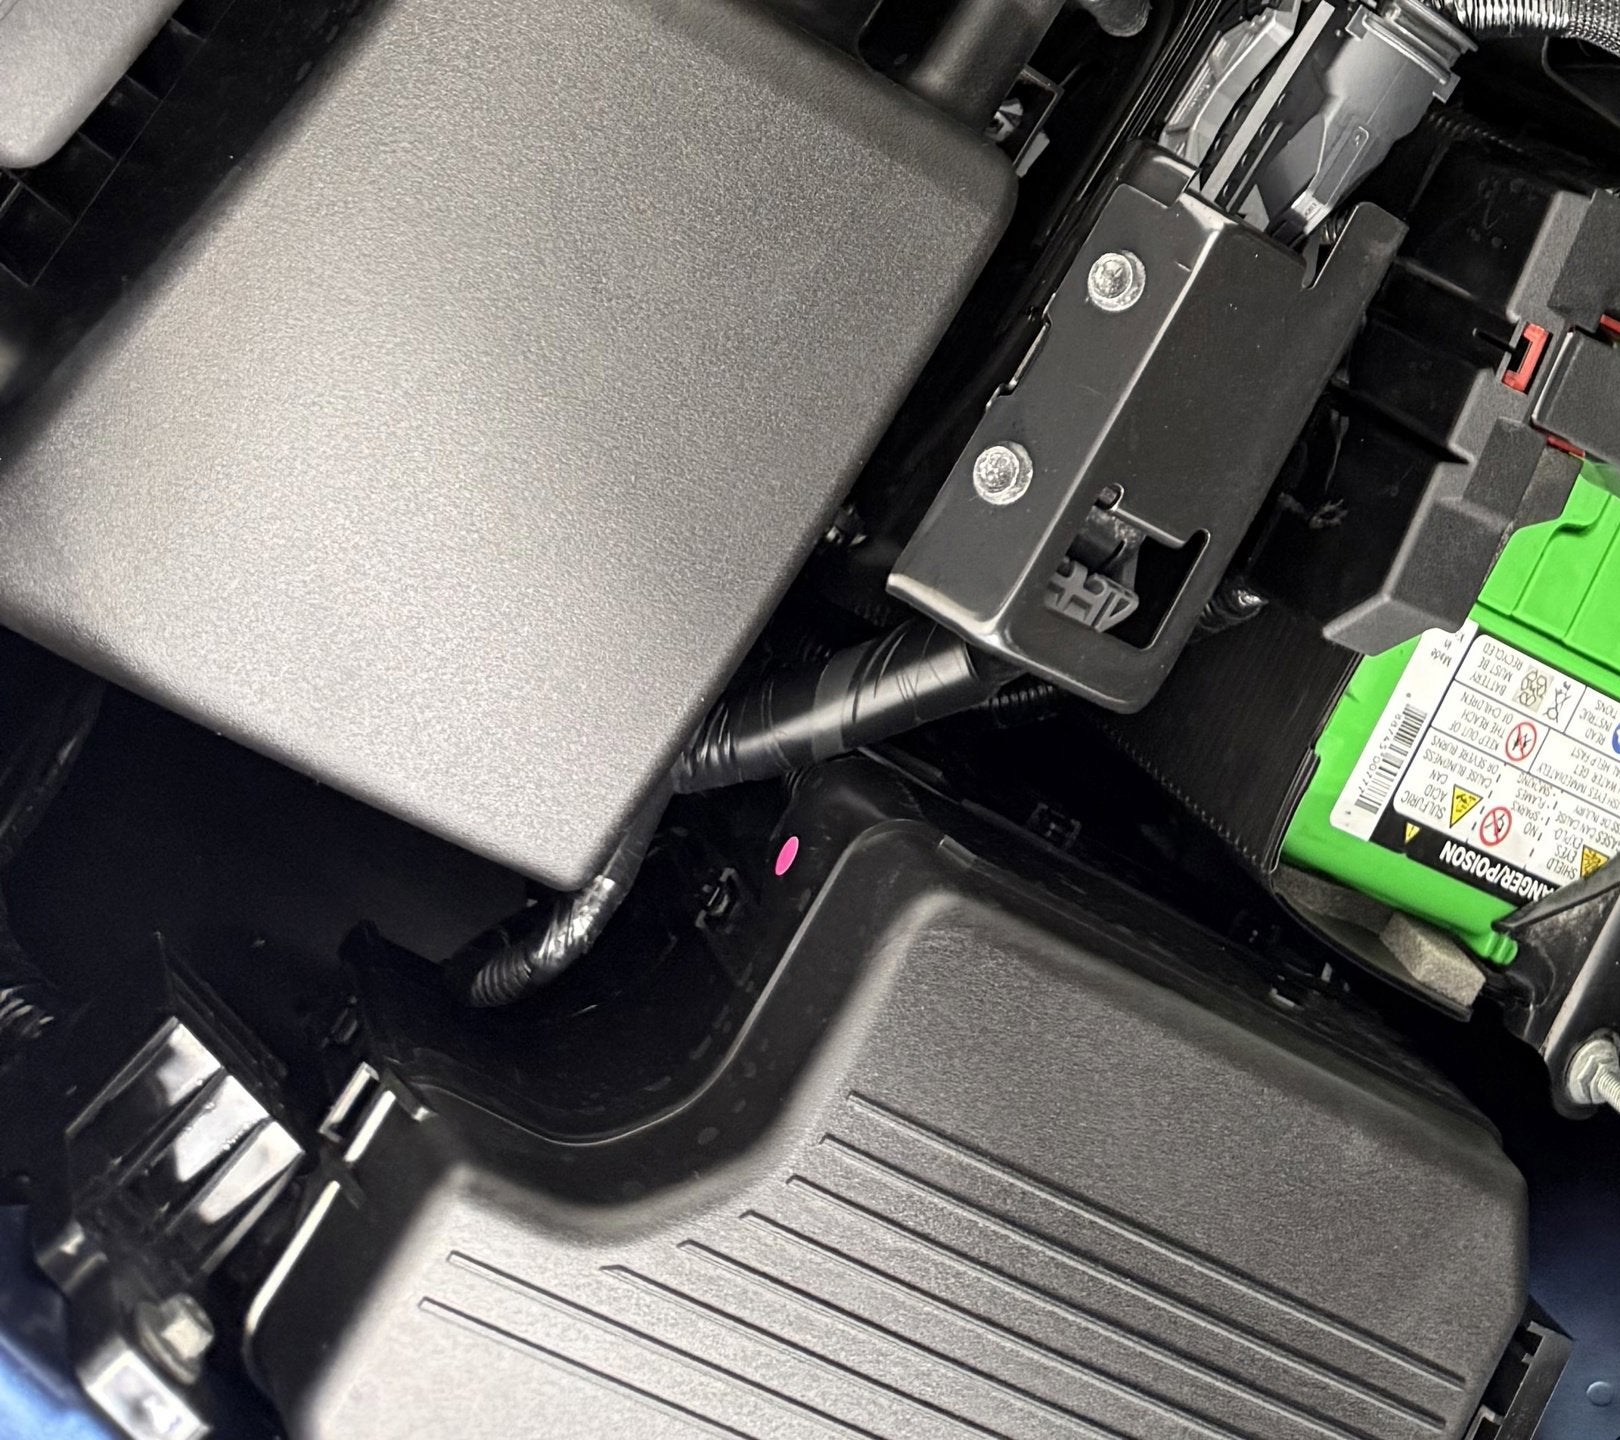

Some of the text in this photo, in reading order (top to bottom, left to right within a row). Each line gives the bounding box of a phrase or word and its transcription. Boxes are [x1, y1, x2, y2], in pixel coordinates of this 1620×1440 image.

[1444, 639, 1452, 650] in
[1430, 648, 1452, 667] Made
[1482, 642, 1523, 671] RECYCLED
[1477, 656, 1513, 682] MUST BE
[1469, 672, 1507, 696] BATTERY
[1460, 691, 1514, 725] OF CHILDREN
[1594, 699, 1618, 719] TIONS
[1461, 709, 1505, 739] THE REACH
[1447, 718, 1500, 751] KEEP OUT OF
[1584, 728, 1606, 746] READ
[1430, 734, 1500, 775] OR SEVERE BURNS
[1570, 747, 1590, 763] FAST
[1422, 748, 1492, 789] CAUSE BLINDNESS
[1572, 764, 1590, 779] GET
[1589, 757, 1611, 773] HELP
[1429, 769, 1449, 785] CAN
[1516, 771, 1553, 796] SMOKING
[1538, 763, 1588, 794] IMMEDIATELY
[1590, 772, 1618, 792] WATER
[1423, 784, 1448, 802] ACID
[1515, 788, 1546, 809] FLAMES
[1587, 786, 1608, 804] EYES
[1400, 790, 1446, 819] SULFURIC
[1510, 800, 1540, 821] SPARKS
[1574, 805, 1600, 823] INJURY
[1523, 822, 1538, 838] NO
[1554, 810, 1580, 830] CAUSE
[1599, 817, 1612, 829] OR
[1580, 823, 1597, 839] CAN
[1438, 838, 1556, 907] ANGER/POISON
[1546, 857, 1578, 880] SHIELD
